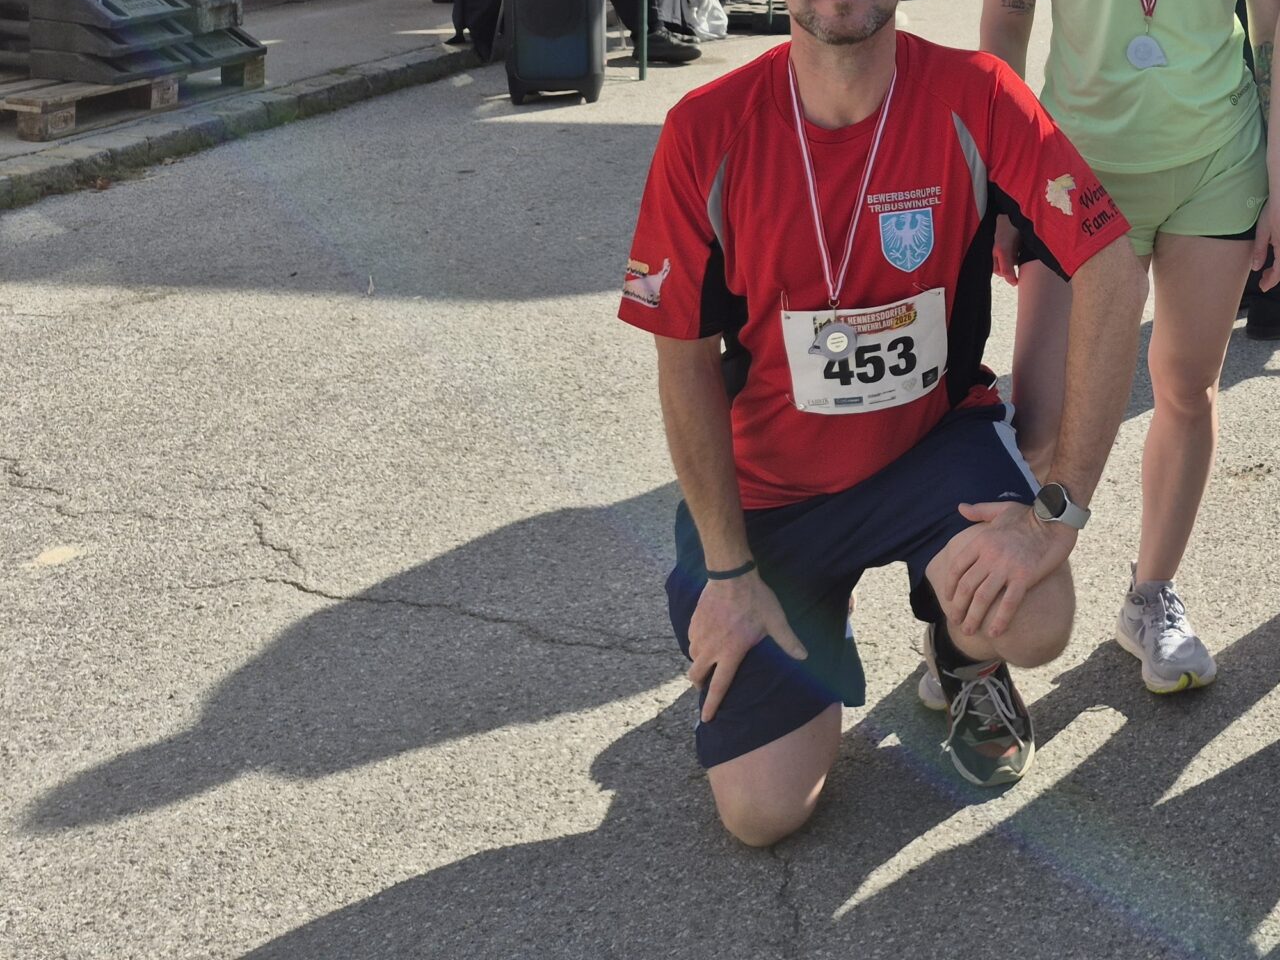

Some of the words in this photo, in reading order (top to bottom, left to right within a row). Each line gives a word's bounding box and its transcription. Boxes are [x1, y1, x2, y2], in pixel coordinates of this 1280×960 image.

[866, 186, 942, 204] BEWERBSGRUPPE
[868, 197, 942, 214] TRIBUSWINKEL
[847, 305, 907, 326] HENNERSDORFER
[823, 335, 918, 387] 453
